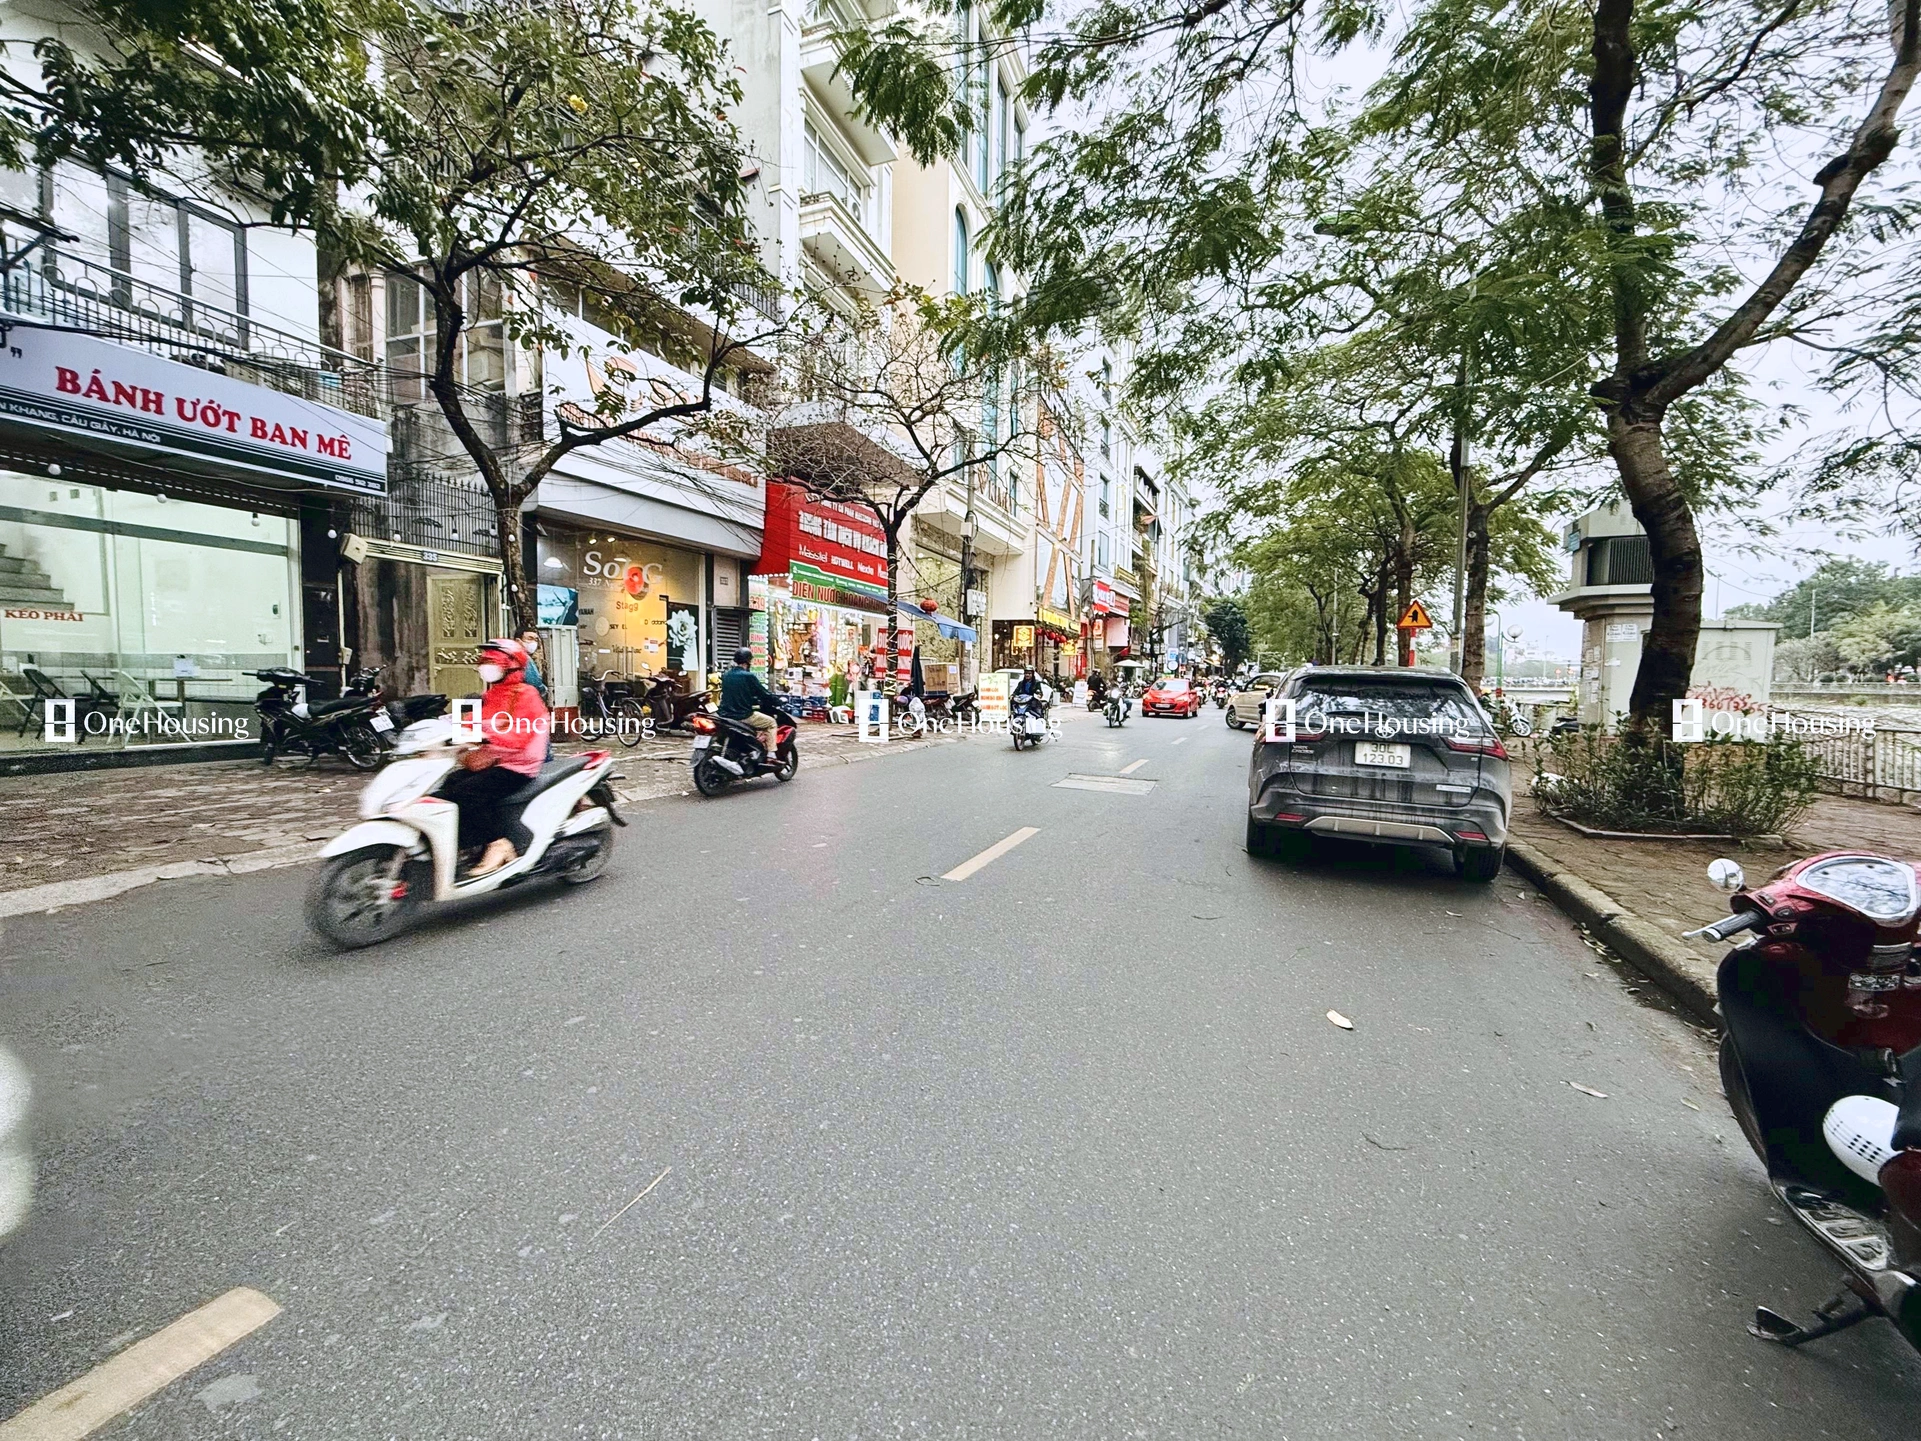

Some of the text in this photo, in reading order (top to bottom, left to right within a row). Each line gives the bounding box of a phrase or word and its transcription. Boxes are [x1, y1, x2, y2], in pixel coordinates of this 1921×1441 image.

[55, 366, 351, 460] BÁNH ƯỚT BAN MÊ
[616, 601, 639, 612] Stagg
[1371, 743, 1394, 754] 30L
[1363, 753, 1404, 766] 123.03
